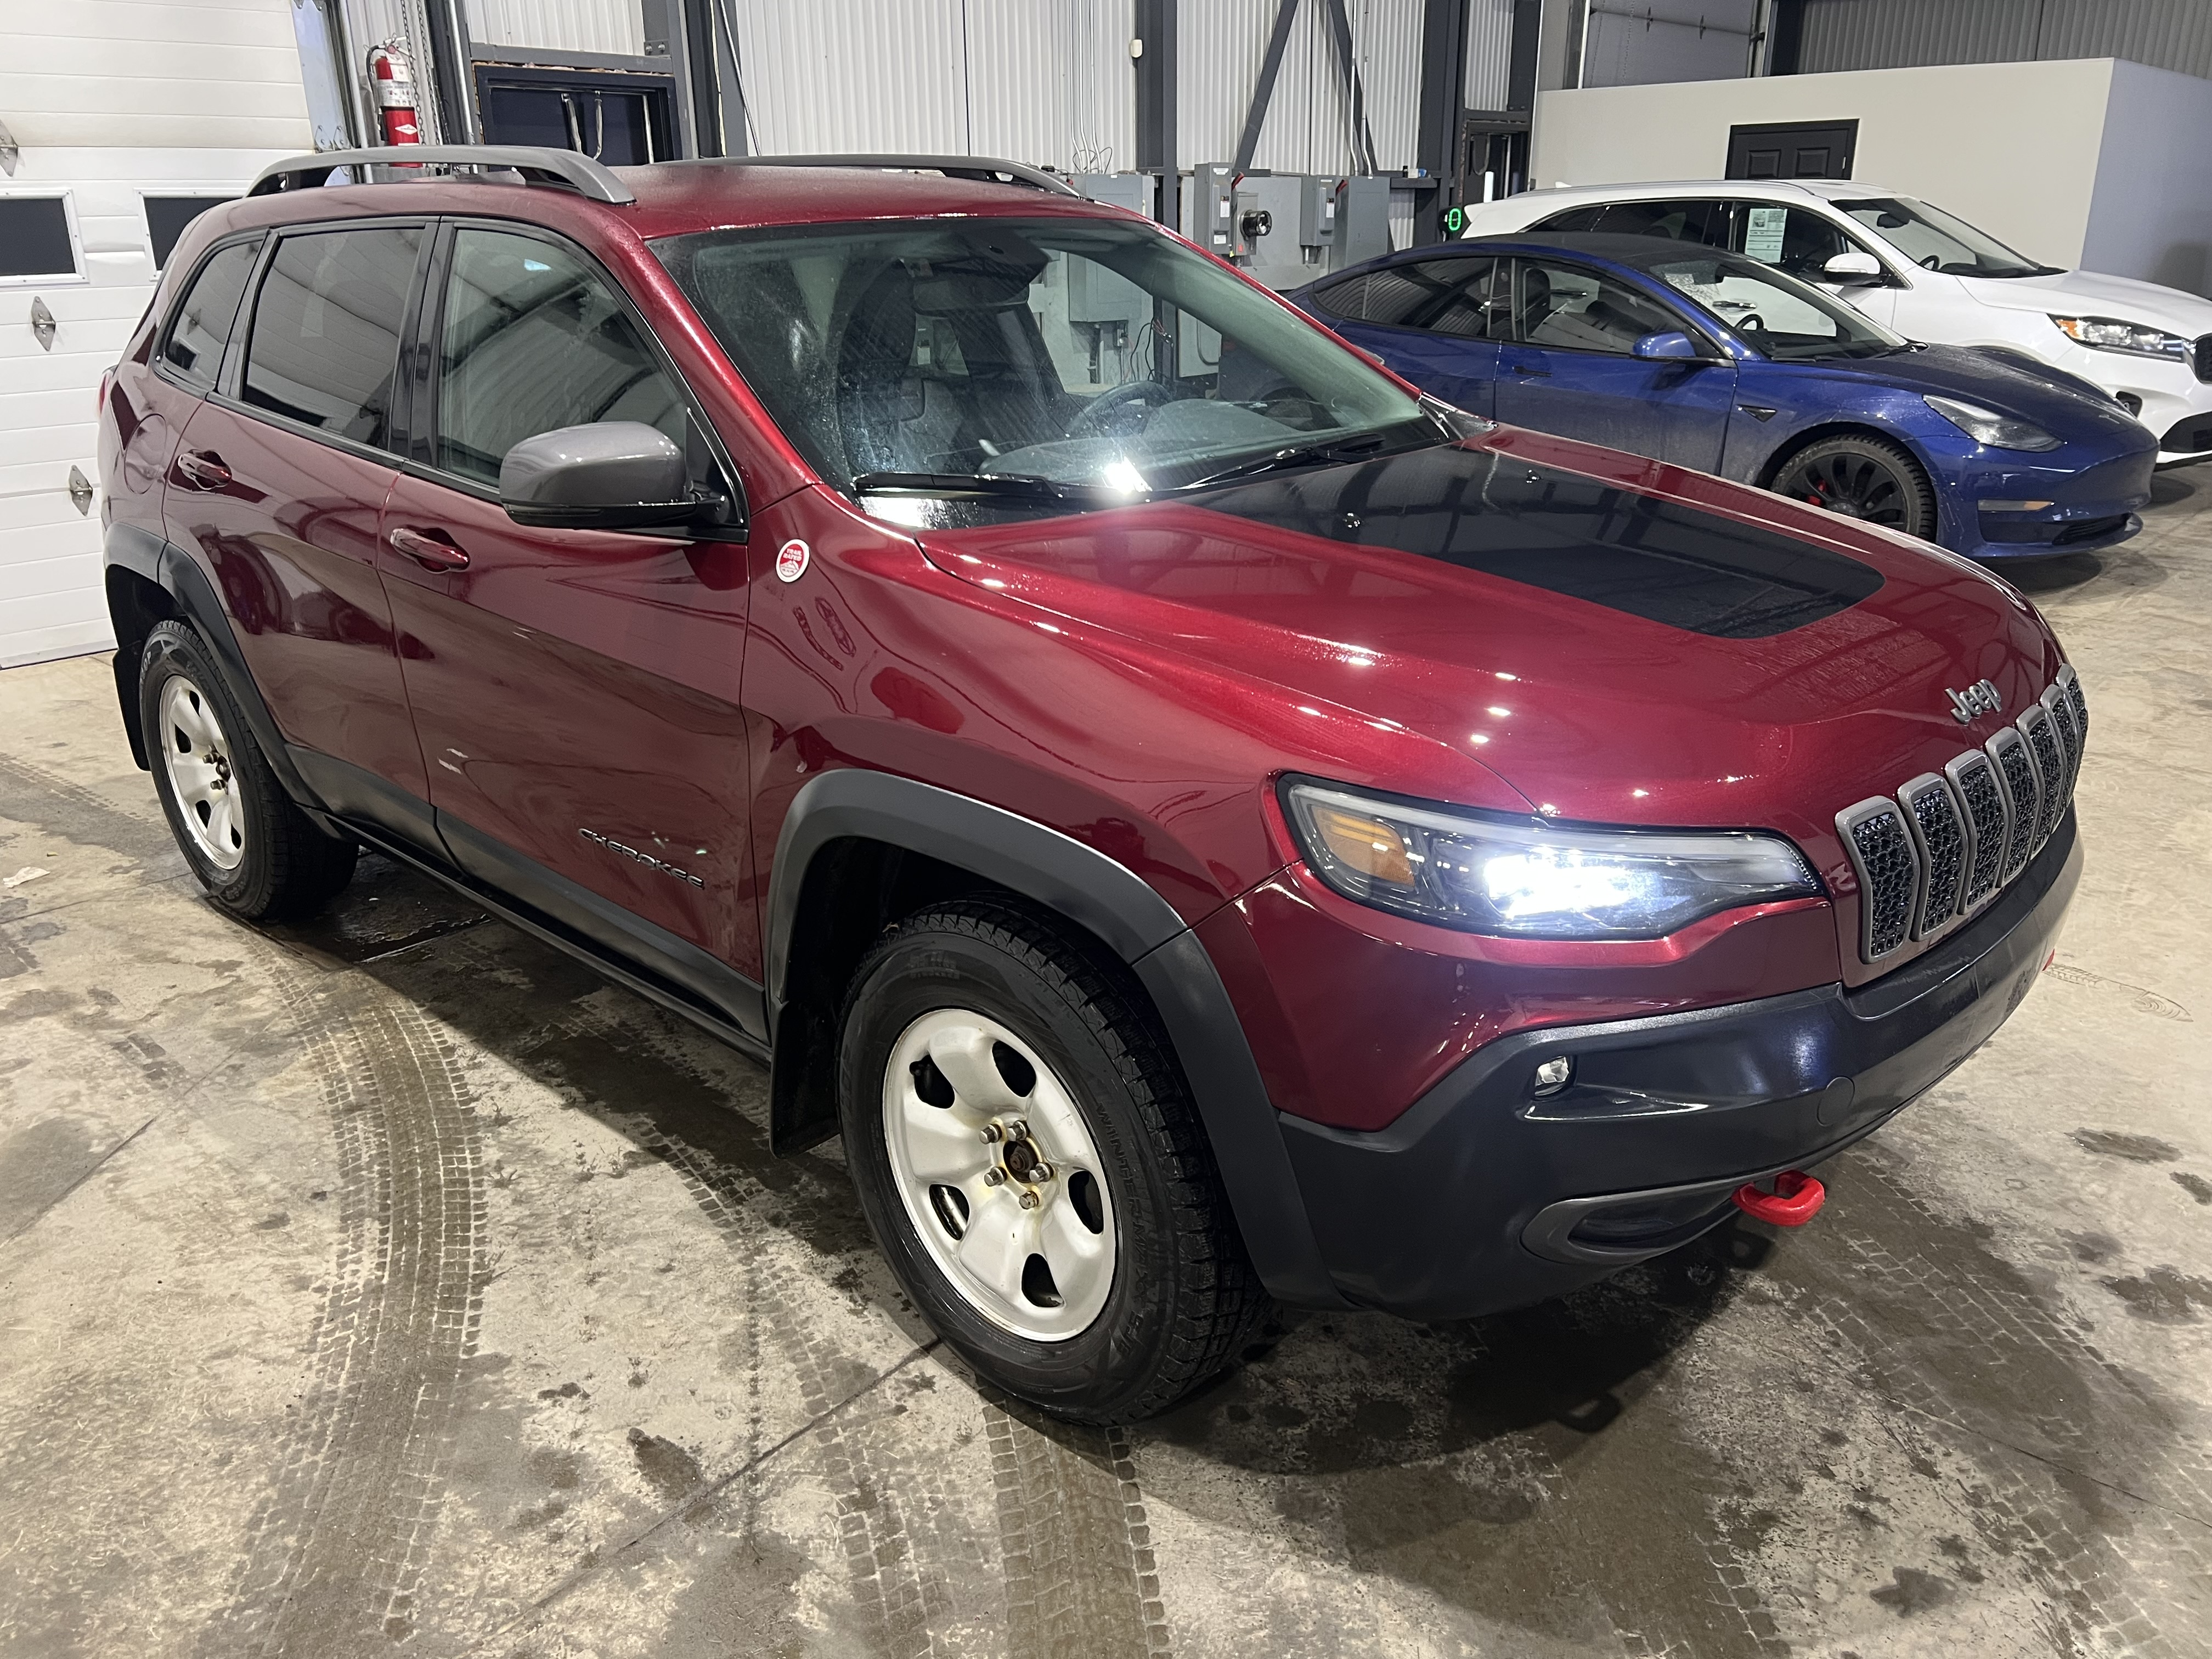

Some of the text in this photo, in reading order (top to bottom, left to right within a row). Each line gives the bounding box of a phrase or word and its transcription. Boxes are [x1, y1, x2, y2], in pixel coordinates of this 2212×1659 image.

[783, 552, 802, 562] RATED
[787, 548, 802, 556] TRAIL
[1944, 679, 2002, 725] Jeep
[578, 828, 704, 890] CHEROKEE
